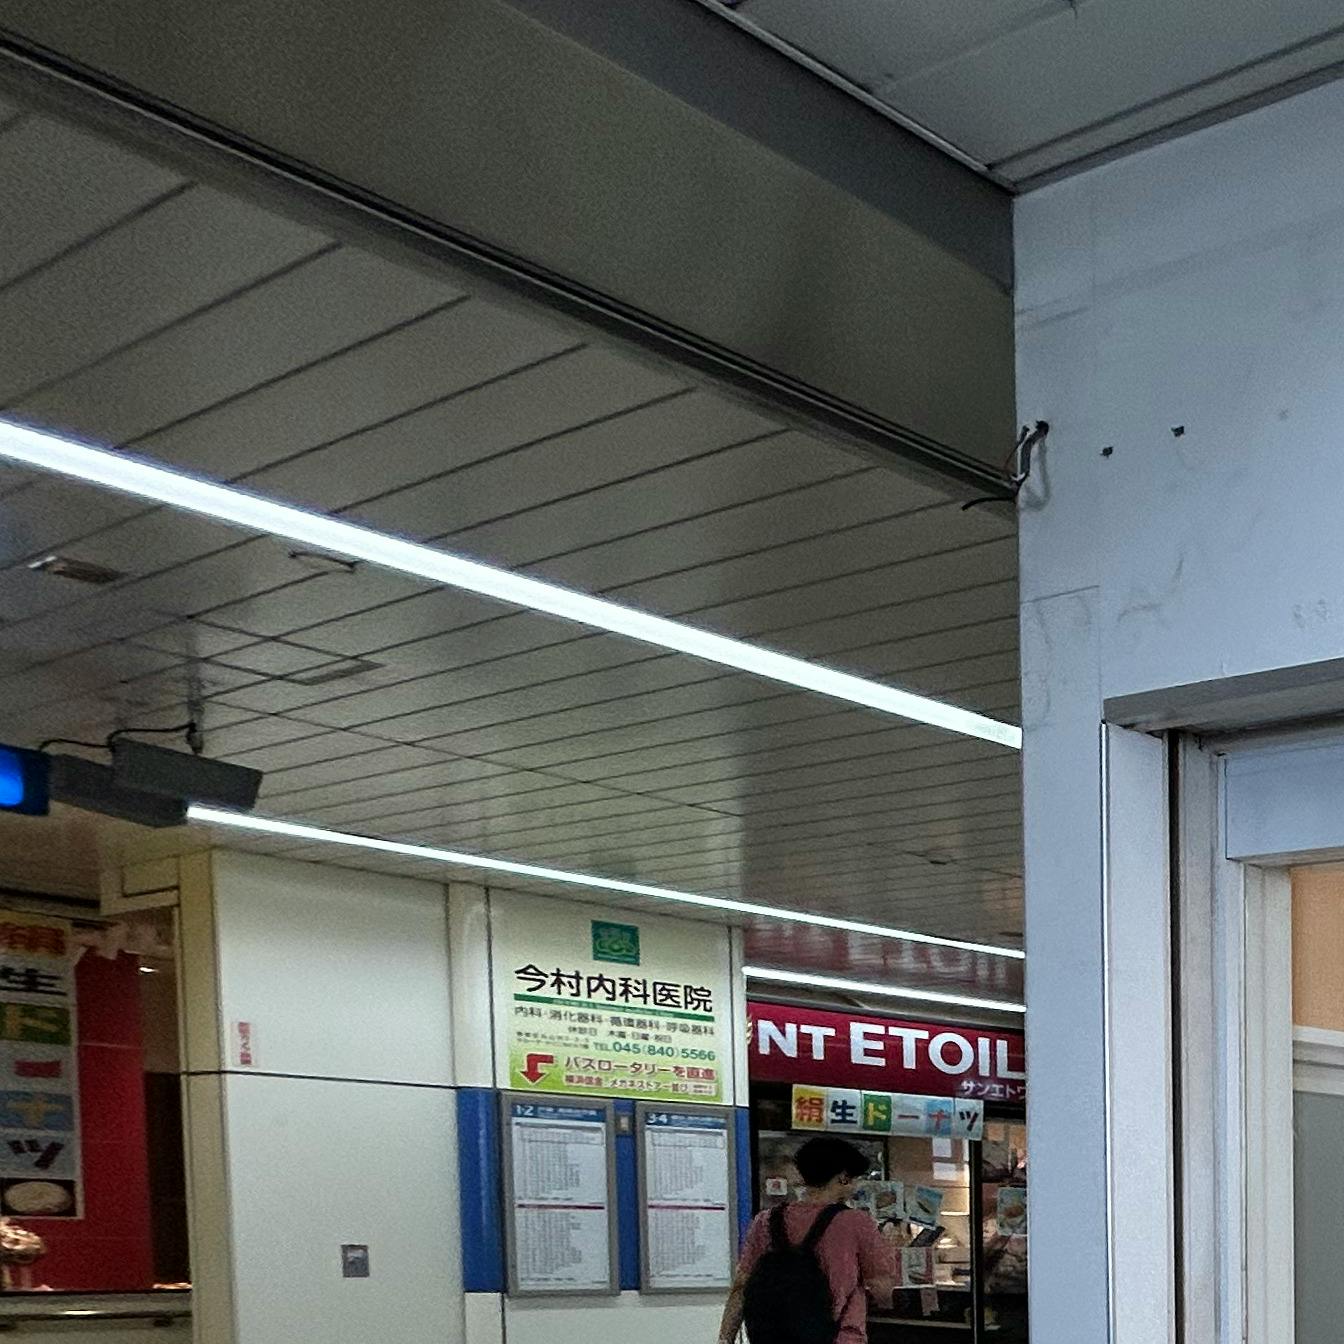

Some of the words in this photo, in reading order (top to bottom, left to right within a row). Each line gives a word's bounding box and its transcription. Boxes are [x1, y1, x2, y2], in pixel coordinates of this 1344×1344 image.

[514, 964, 713, 1012] 今村内科医院
[849, 1021, 1026, 1079] ETOIL
